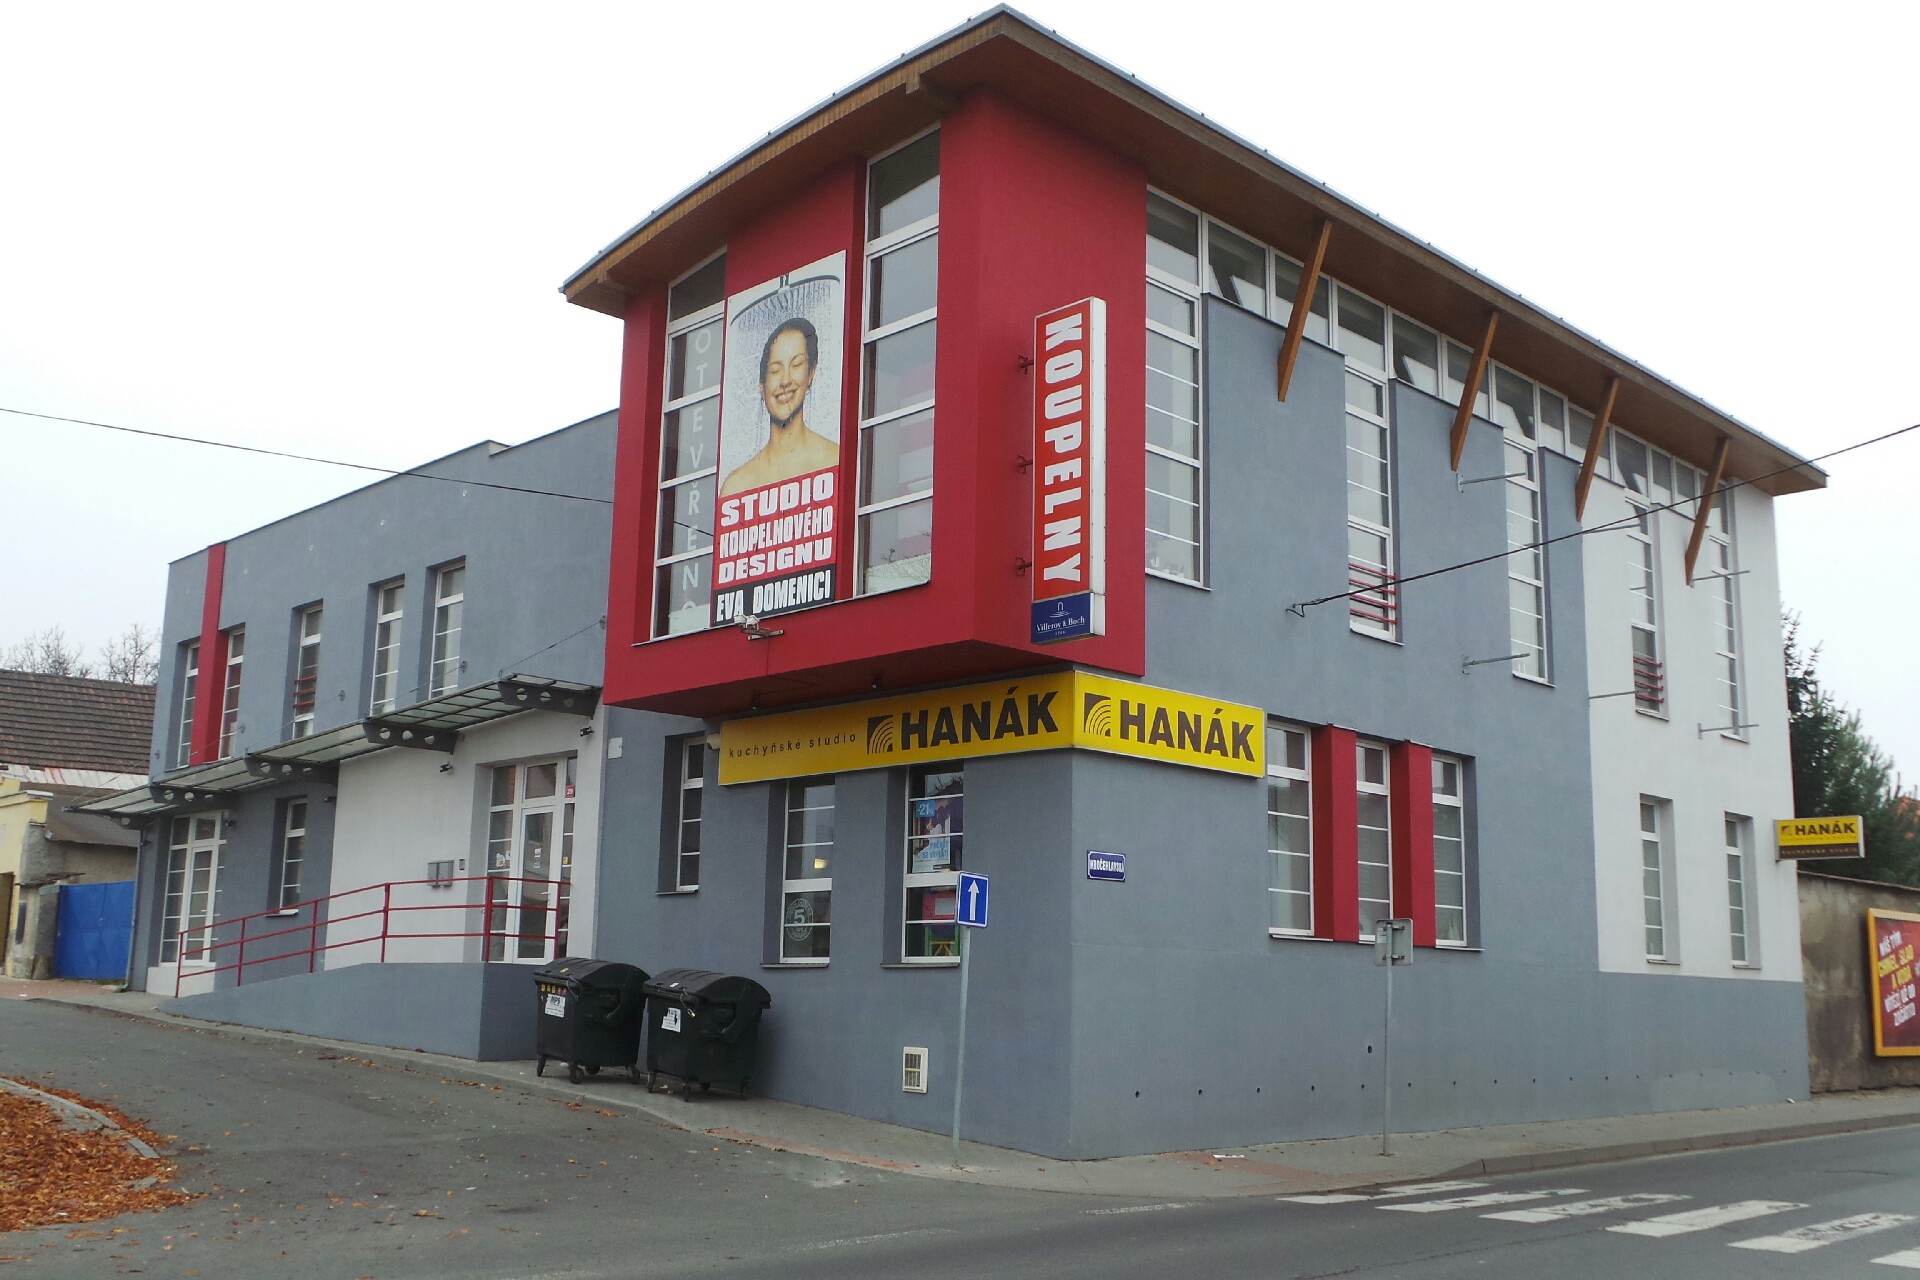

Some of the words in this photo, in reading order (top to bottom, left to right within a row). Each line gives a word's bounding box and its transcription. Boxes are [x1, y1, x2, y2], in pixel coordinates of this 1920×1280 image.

[1043, 312, 1083, 583] KOUPELNY
[720, 472, 834, 527] STUDIO
[719, 505, 833, 559] KOUPELNOVÉHO
[718, 537, 833, 584] DESIGNU
[716, 590, 744, 622] EVA
[752, 569, 831, 614] DOMENICI
[1036, 622, 1062, 632] Villeroy
[1068, 616, 1085, 626] Boch
[728, 738, 801, 759] kuchyňské
[809, 732, 856, 748] studio
[901, 686, 1059, 750] HANÁK
[1119, 699, 1256, 762] HANÁK
[1795, 821, 1856, 836] HANÁK
